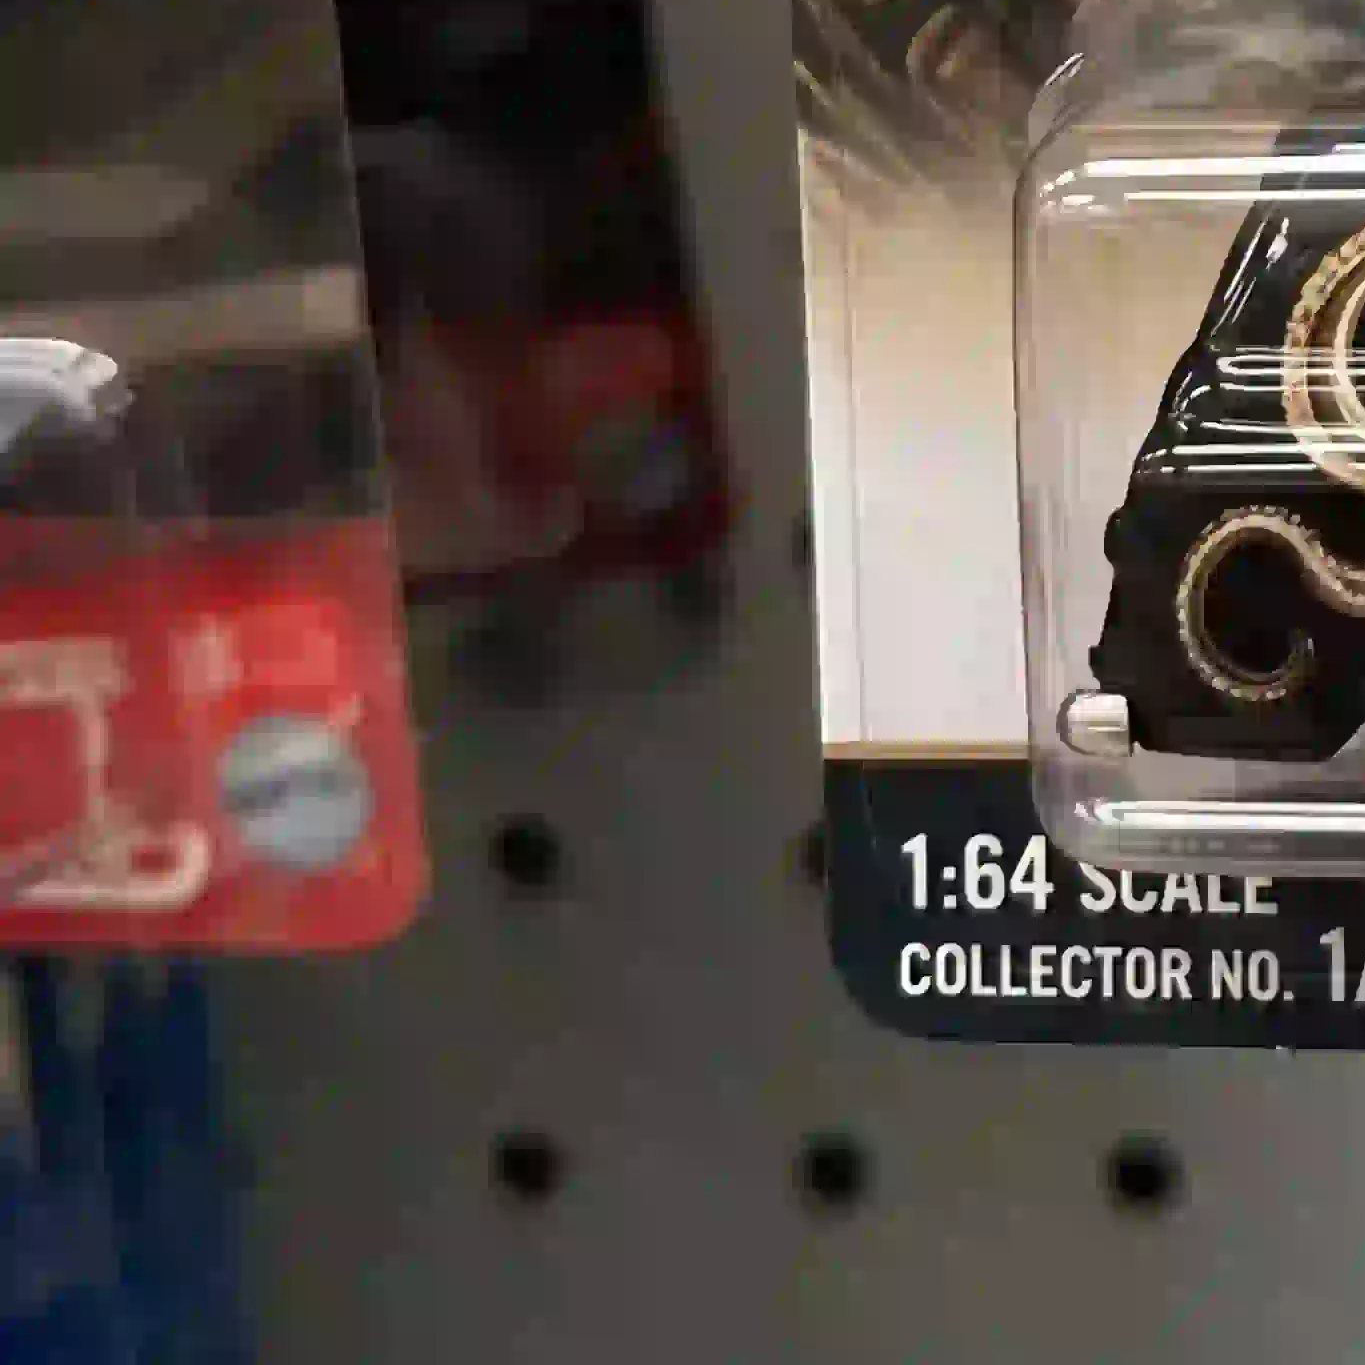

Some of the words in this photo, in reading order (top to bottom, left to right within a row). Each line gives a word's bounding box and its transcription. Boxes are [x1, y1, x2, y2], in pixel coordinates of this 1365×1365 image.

[902, 833, 1054, 910] 1:64
[1080, 862, 1278, 914] SCALE
[901, 943, 1192, 999] COLLECTOR
[1212, 950, 1294, 1001] NO.
